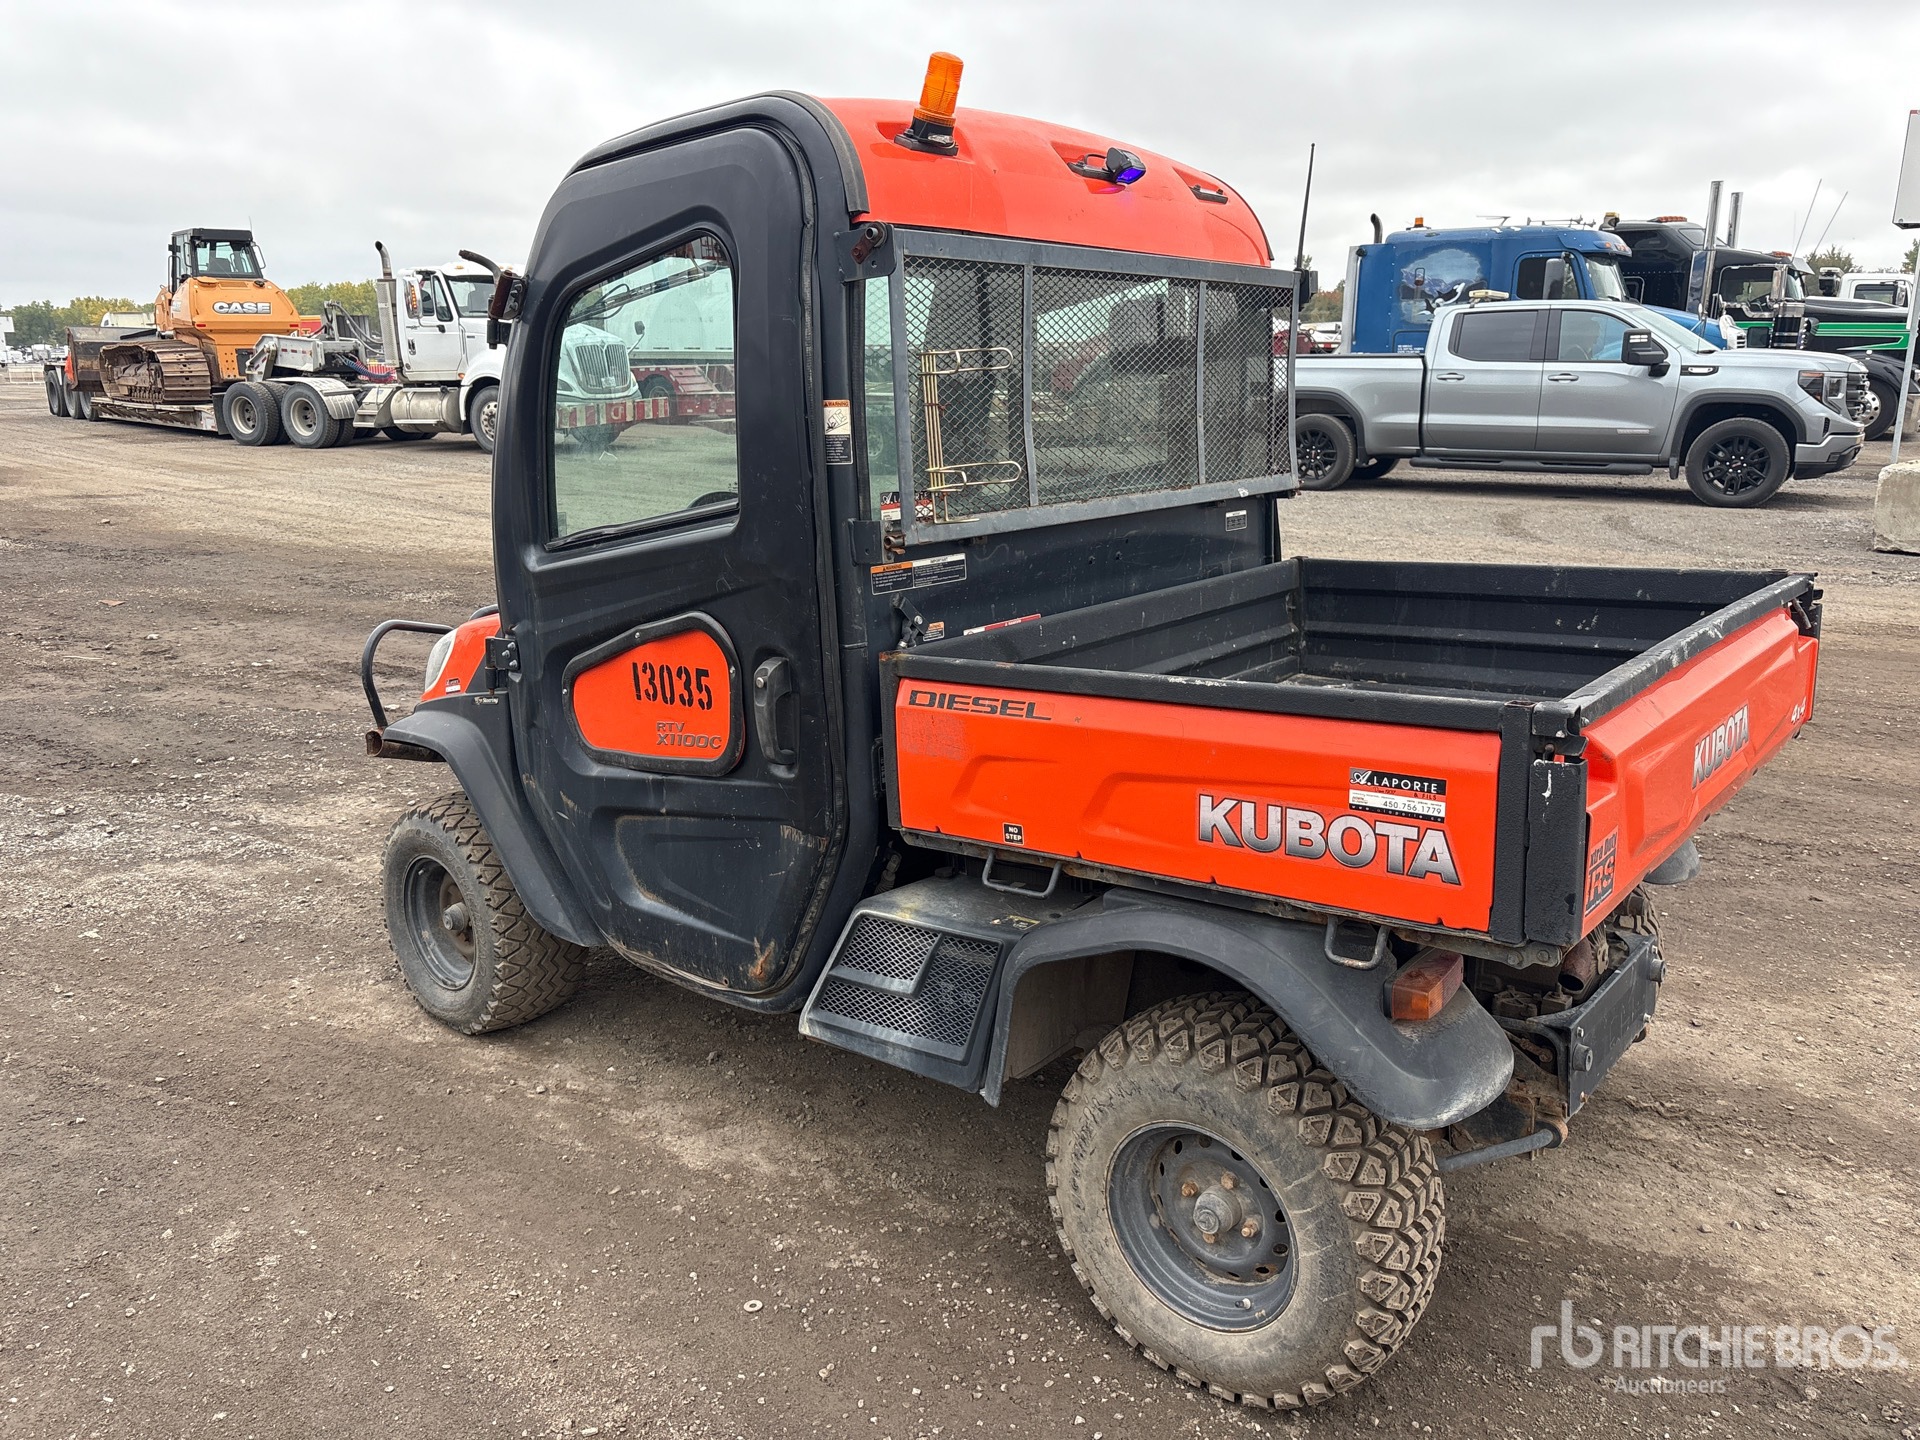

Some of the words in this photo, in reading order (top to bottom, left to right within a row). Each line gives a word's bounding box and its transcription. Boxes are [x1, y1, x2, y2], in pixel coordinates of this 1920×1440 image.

[213, 301, 272, 314] CASE
[632, 661, 713, 711] 13035
[908, 689, 1052, 721] DIESEL
[656, 720, 685, 732] RTV
[656, 733, 723, 749] X1100C
[1691, 704, 1749, 790] KUBOTA
[1373, 775, 1438, 794] LAPORTE
[1382, 800, 1442, 815] 450.756.1779
[1199, 794, 1461, 885] KUBOTA
